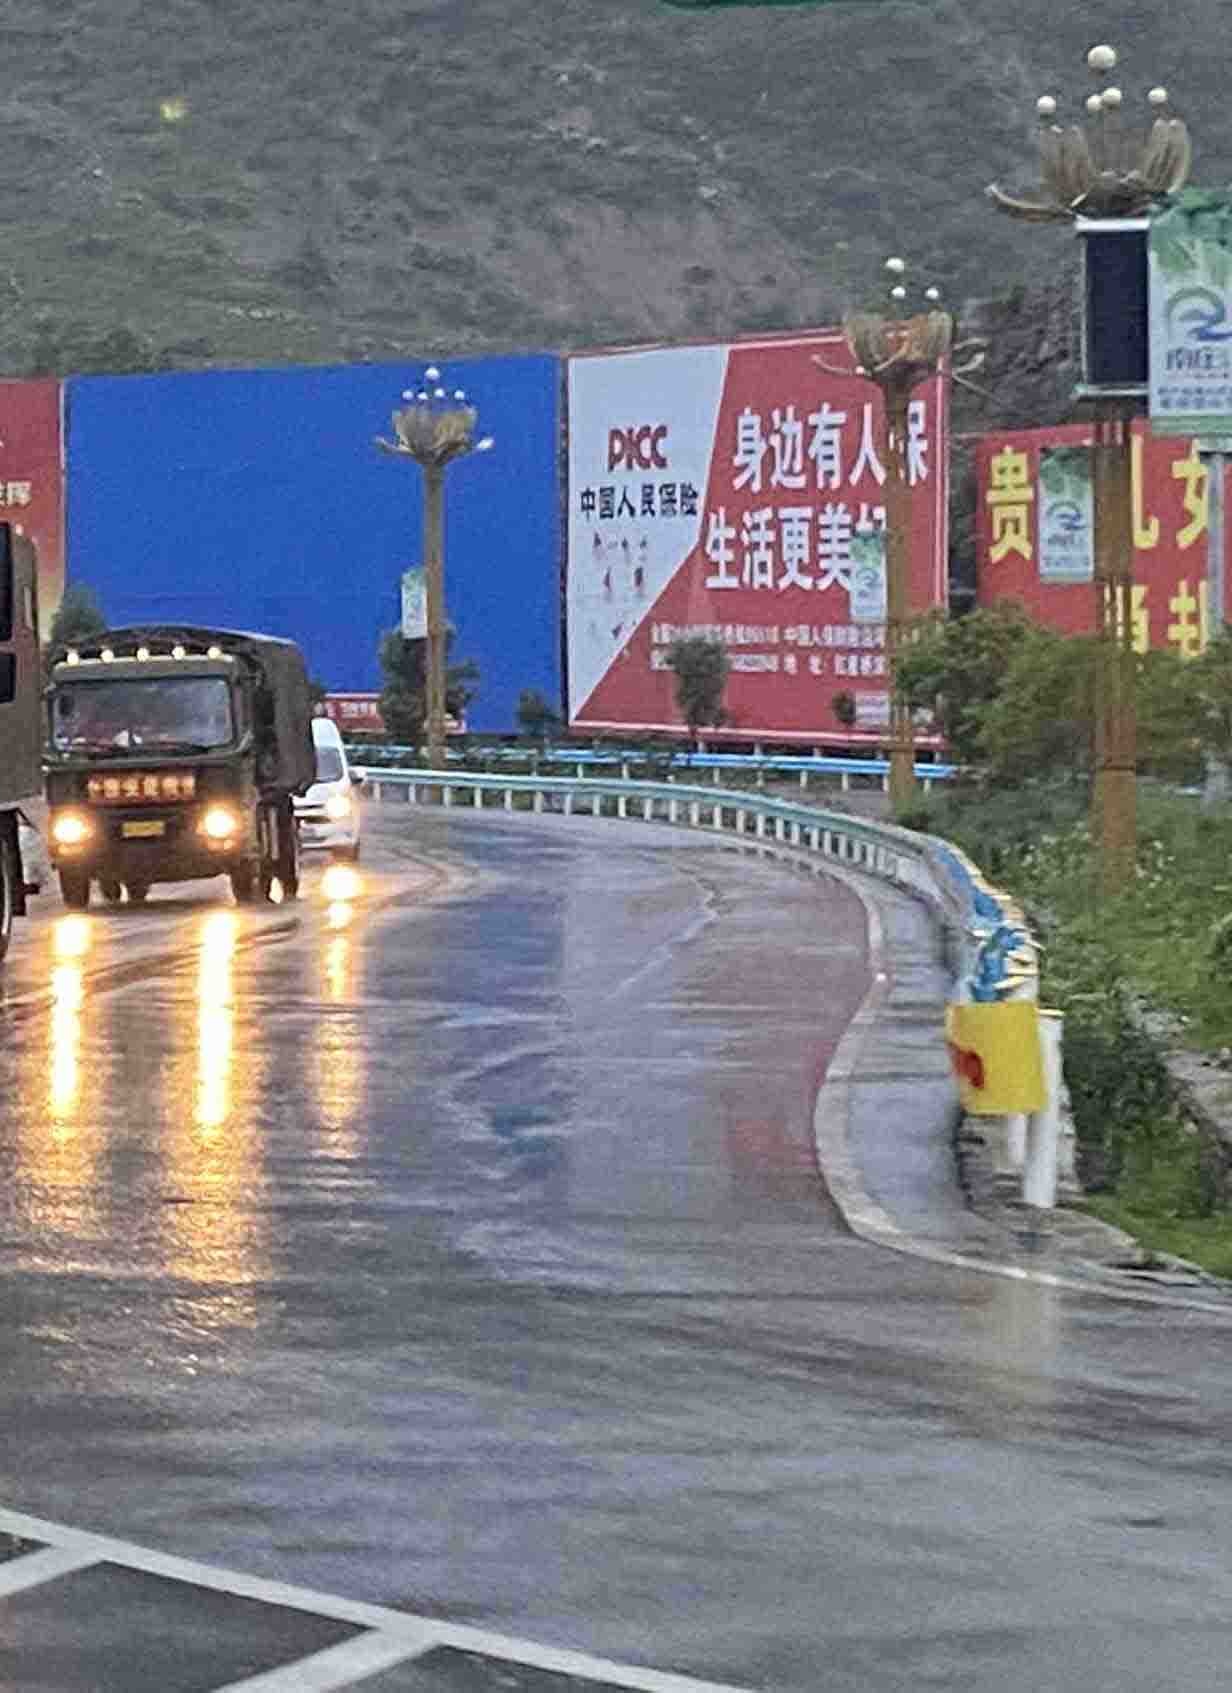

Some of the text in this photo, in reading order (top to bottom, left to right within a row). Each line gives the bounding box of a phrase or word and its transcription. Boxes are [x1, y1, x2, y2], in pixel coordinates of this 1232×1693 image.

[607, 424, 668, 473] PICC
[580, 482, 699, 521] 中国人民保险
[704, 503, 888, 592] 生活更美
